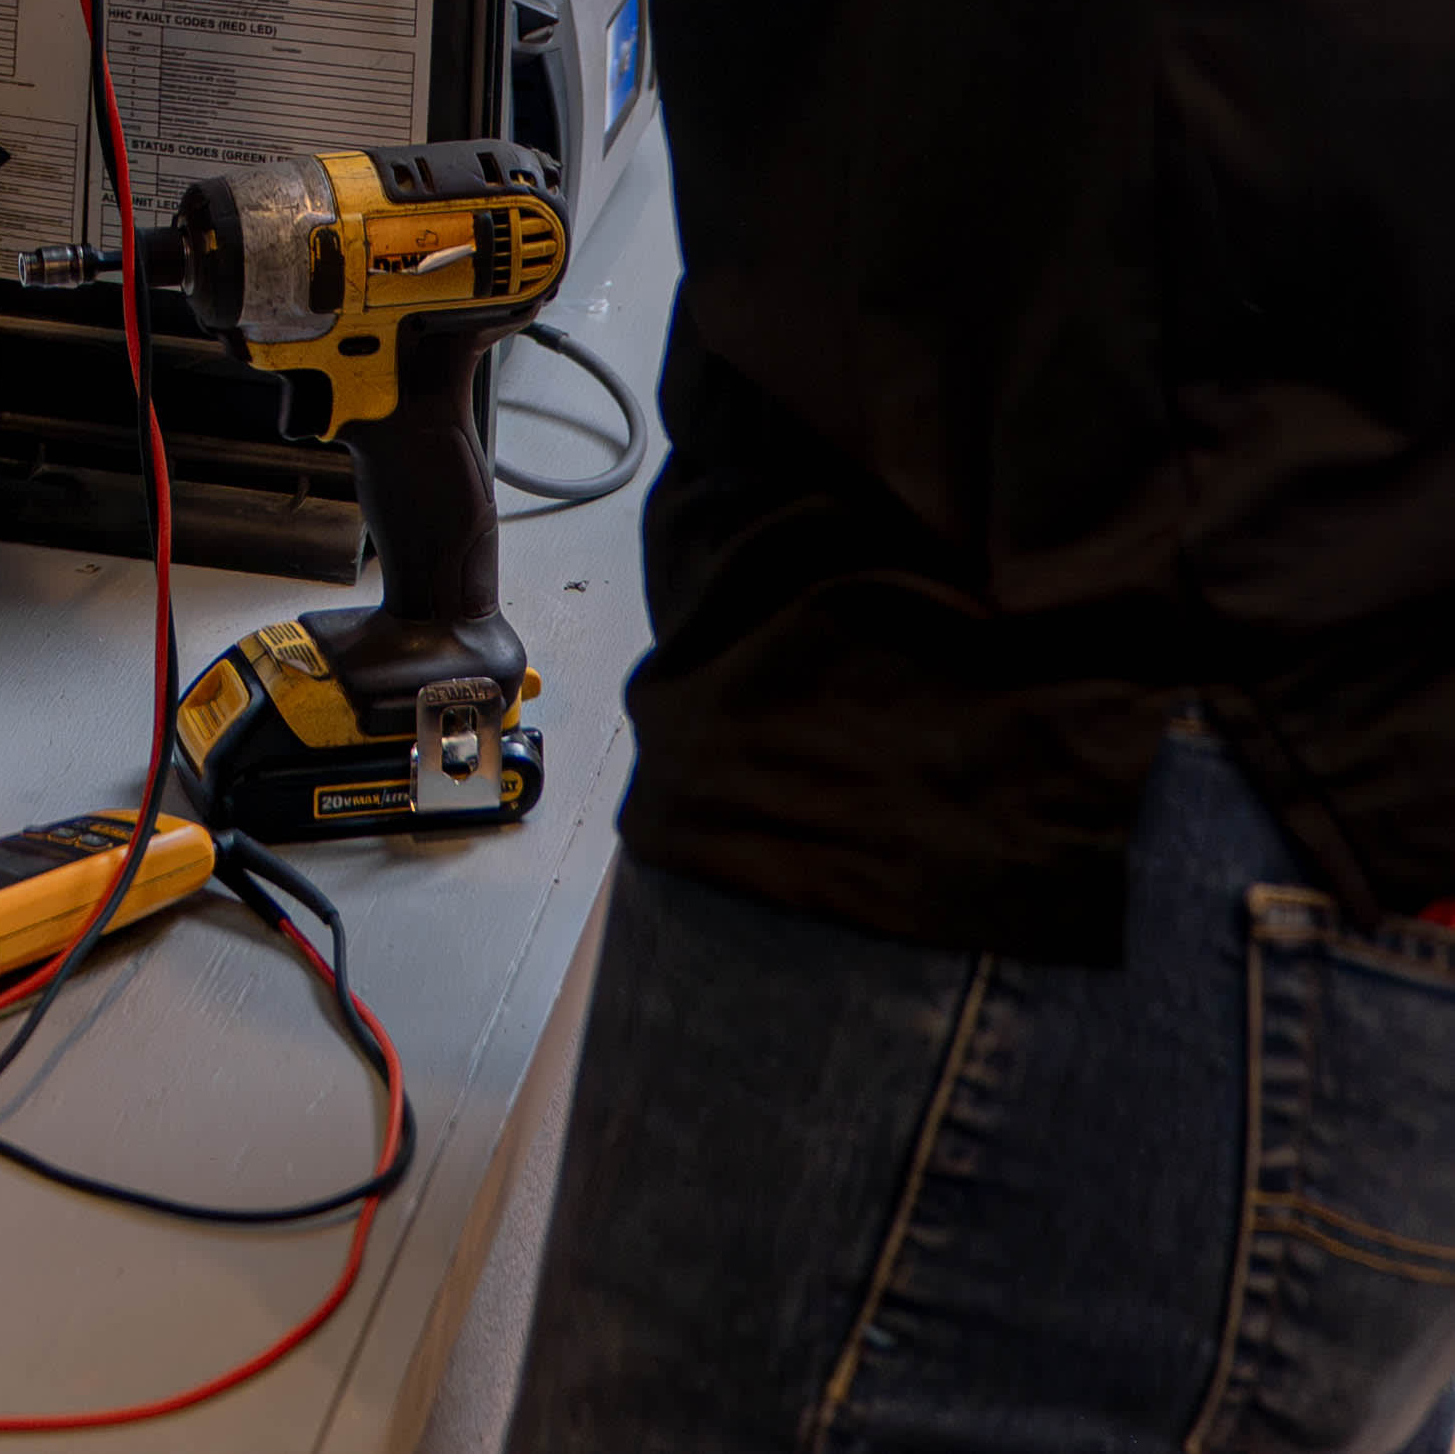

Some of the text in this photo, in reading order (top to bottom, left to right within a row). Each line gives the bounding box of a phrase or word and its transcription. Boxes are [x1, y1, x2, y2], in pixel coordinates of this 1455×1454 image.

[108, 9, 278, 37] HHC FAULT CODES (RED LED)
[131, 140, 175, 154] STATUS
[178, 144, 218, 158] CODES
[221, 149, 266, 164] (GREEN
